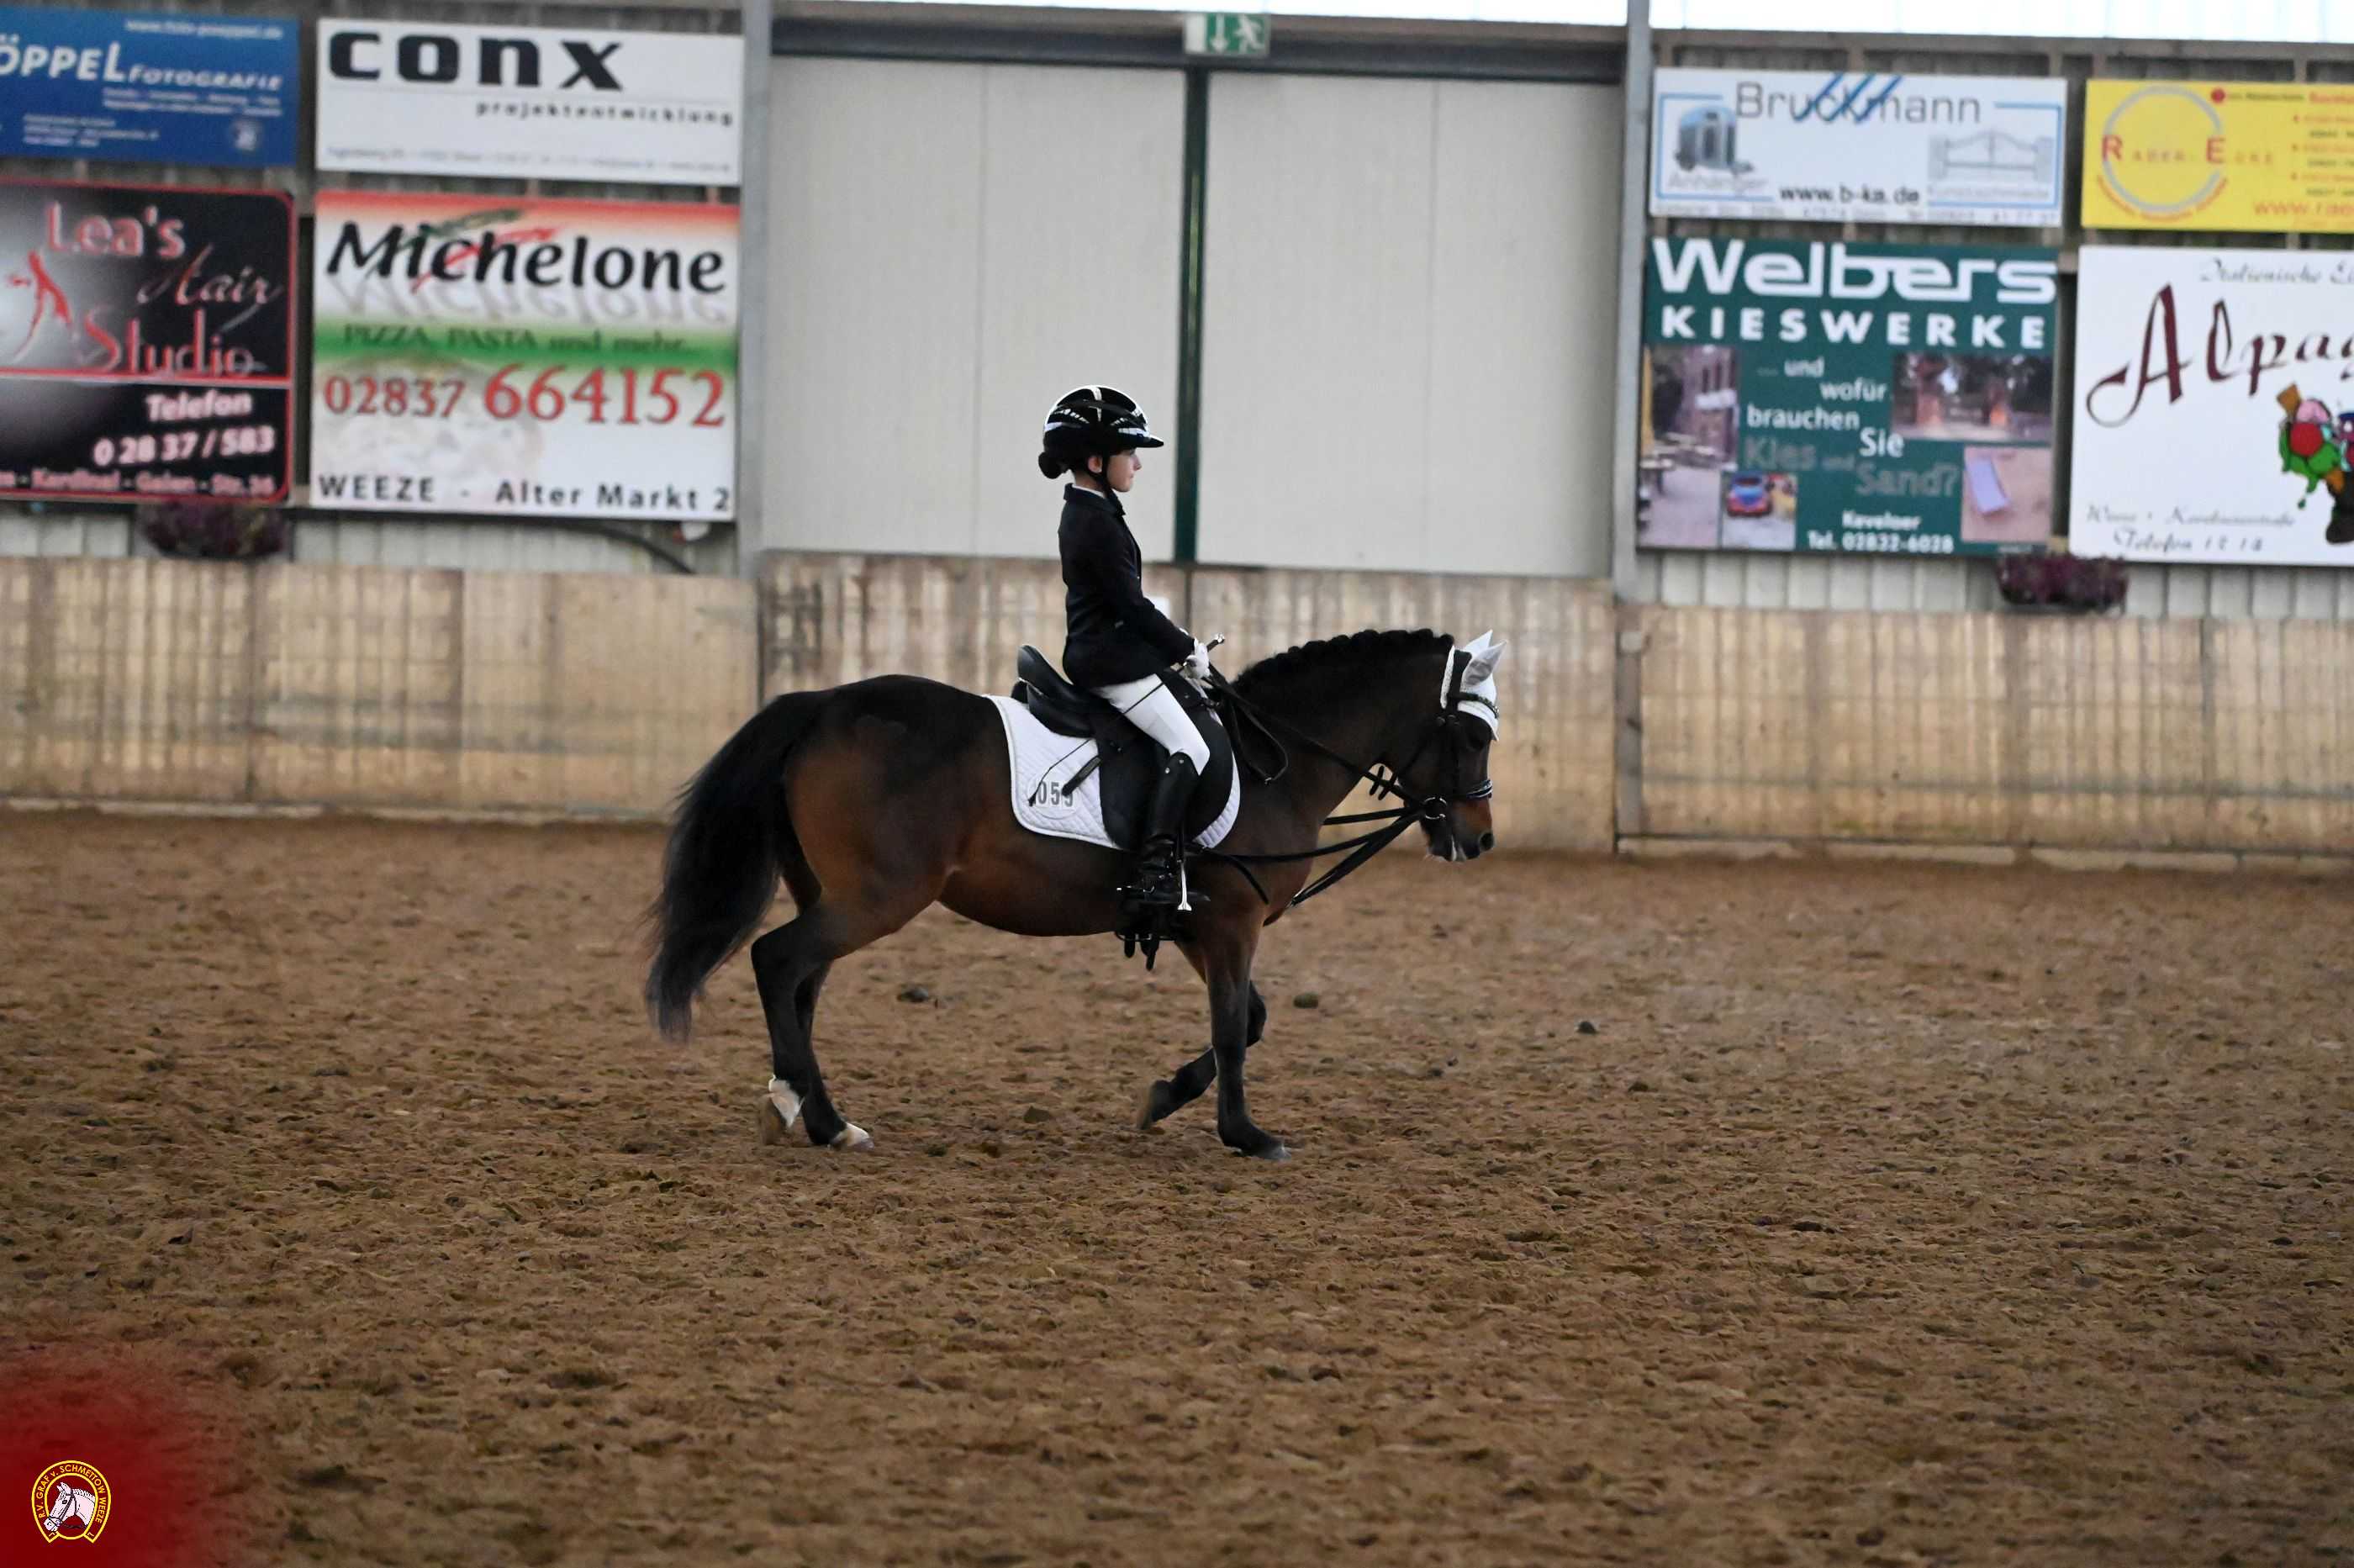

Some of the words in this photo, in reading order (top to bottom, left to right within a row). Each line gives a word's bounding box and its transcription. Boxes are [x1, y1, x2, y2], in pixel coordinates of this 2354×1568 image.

[127, 65, 282, 91] FOTOGRAFIE
[329, 31, 623, 91] conx
[476, 102, 733, 126] projektentwicklung
[47, 200, 185, 259] Lea's
[326, 220, 726, 294] Michelone
[1652, 237, 2057, 304] Welbers
[80, 304, 267, 373] Studio
[1661, 305, 2045, 350] KIESWERKE
[1783, 356, 1824, 377] und
[145, 389, 252, 422] Telefon
[324, 376, 466, 419] 02837
[483, 364, 726, 429] 664152
[1818, 377, 1887, 402] wofür
[1745, 402, 1860, 430] brauchen
[1859, 426, 1905, 457] Sie
[319, 474, 435, 503] WEEZE
[495, 483, 582, 505] Alter
[597, 484, 698, 511] Markt
[713, 486, 731, 513] 2
[1855, 460, 1961, 497] Sand?
